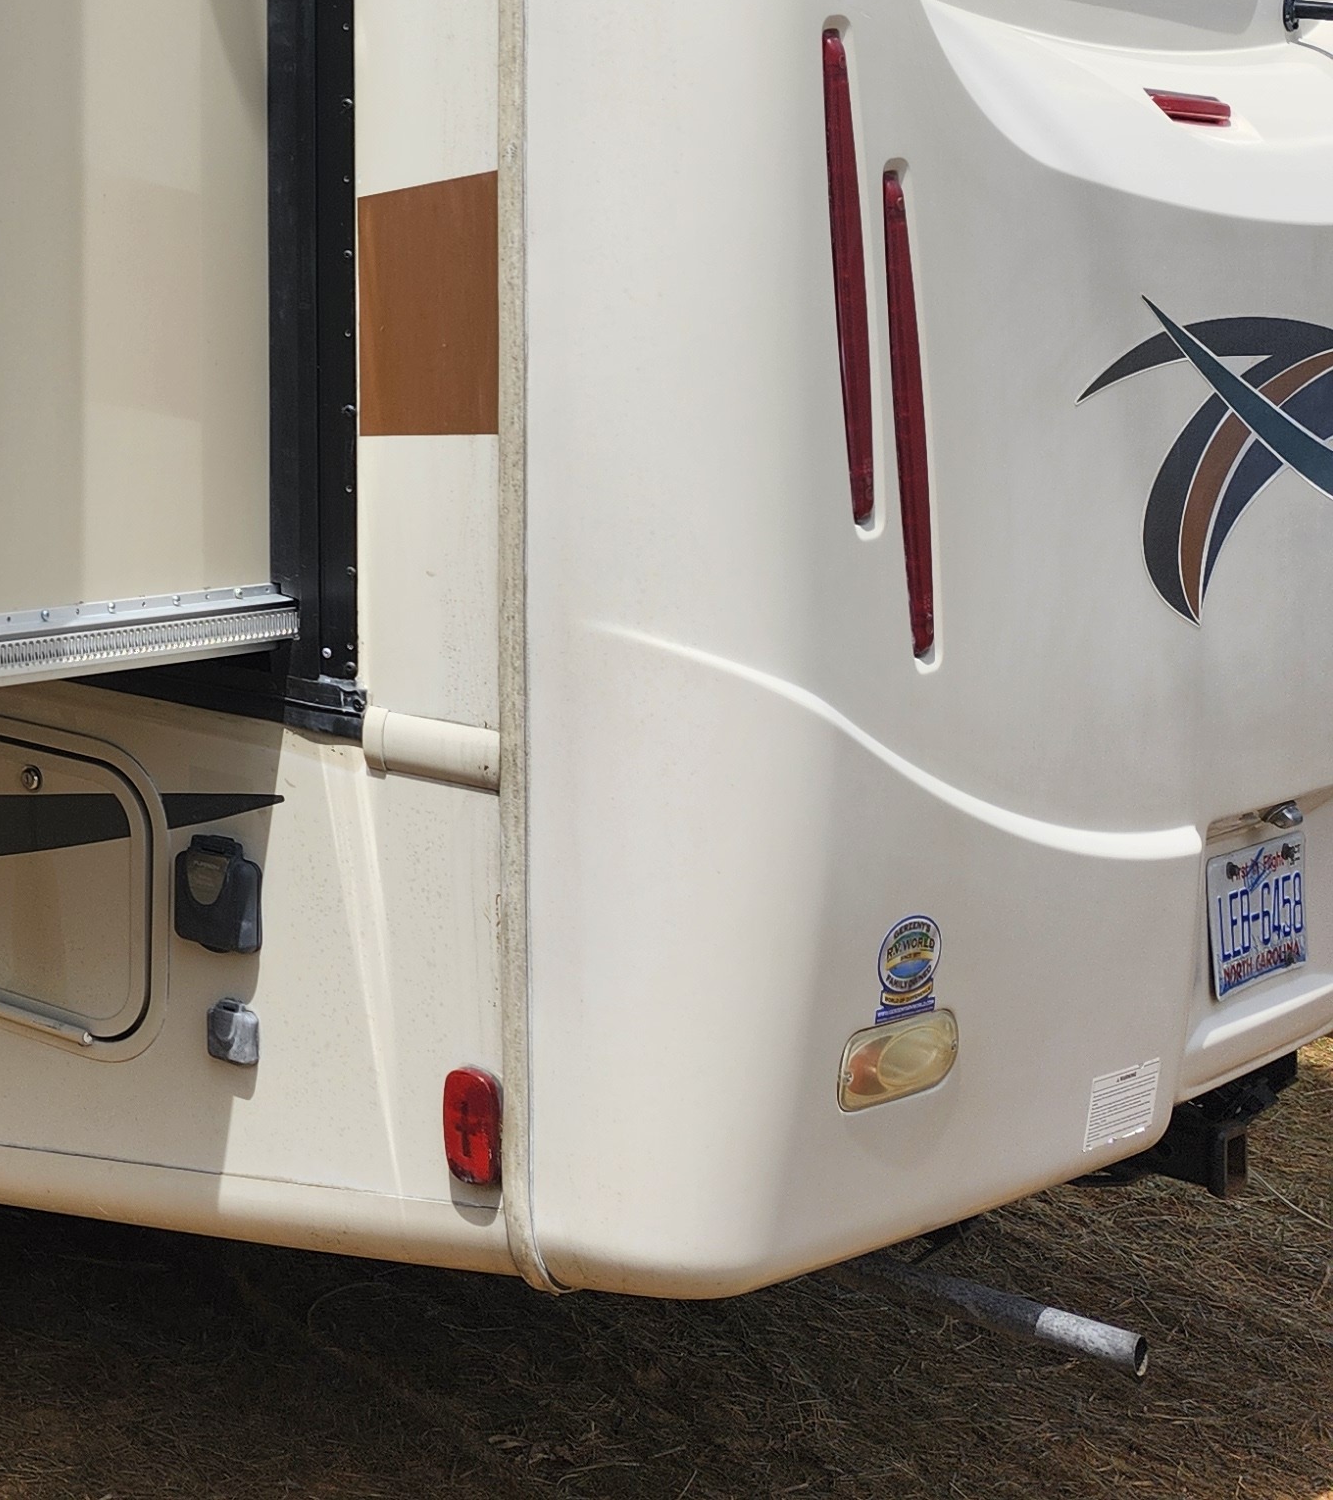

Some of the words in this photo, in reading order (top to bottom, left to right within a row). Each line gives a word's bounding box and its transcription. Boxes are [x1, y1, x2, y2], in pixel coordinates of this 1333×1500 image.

[1217, 871, 1304, 963] LEB-6458
[1223, 957, 1253, 983] NORTH
[1255, 940, 1301, 972] CAROLINA
